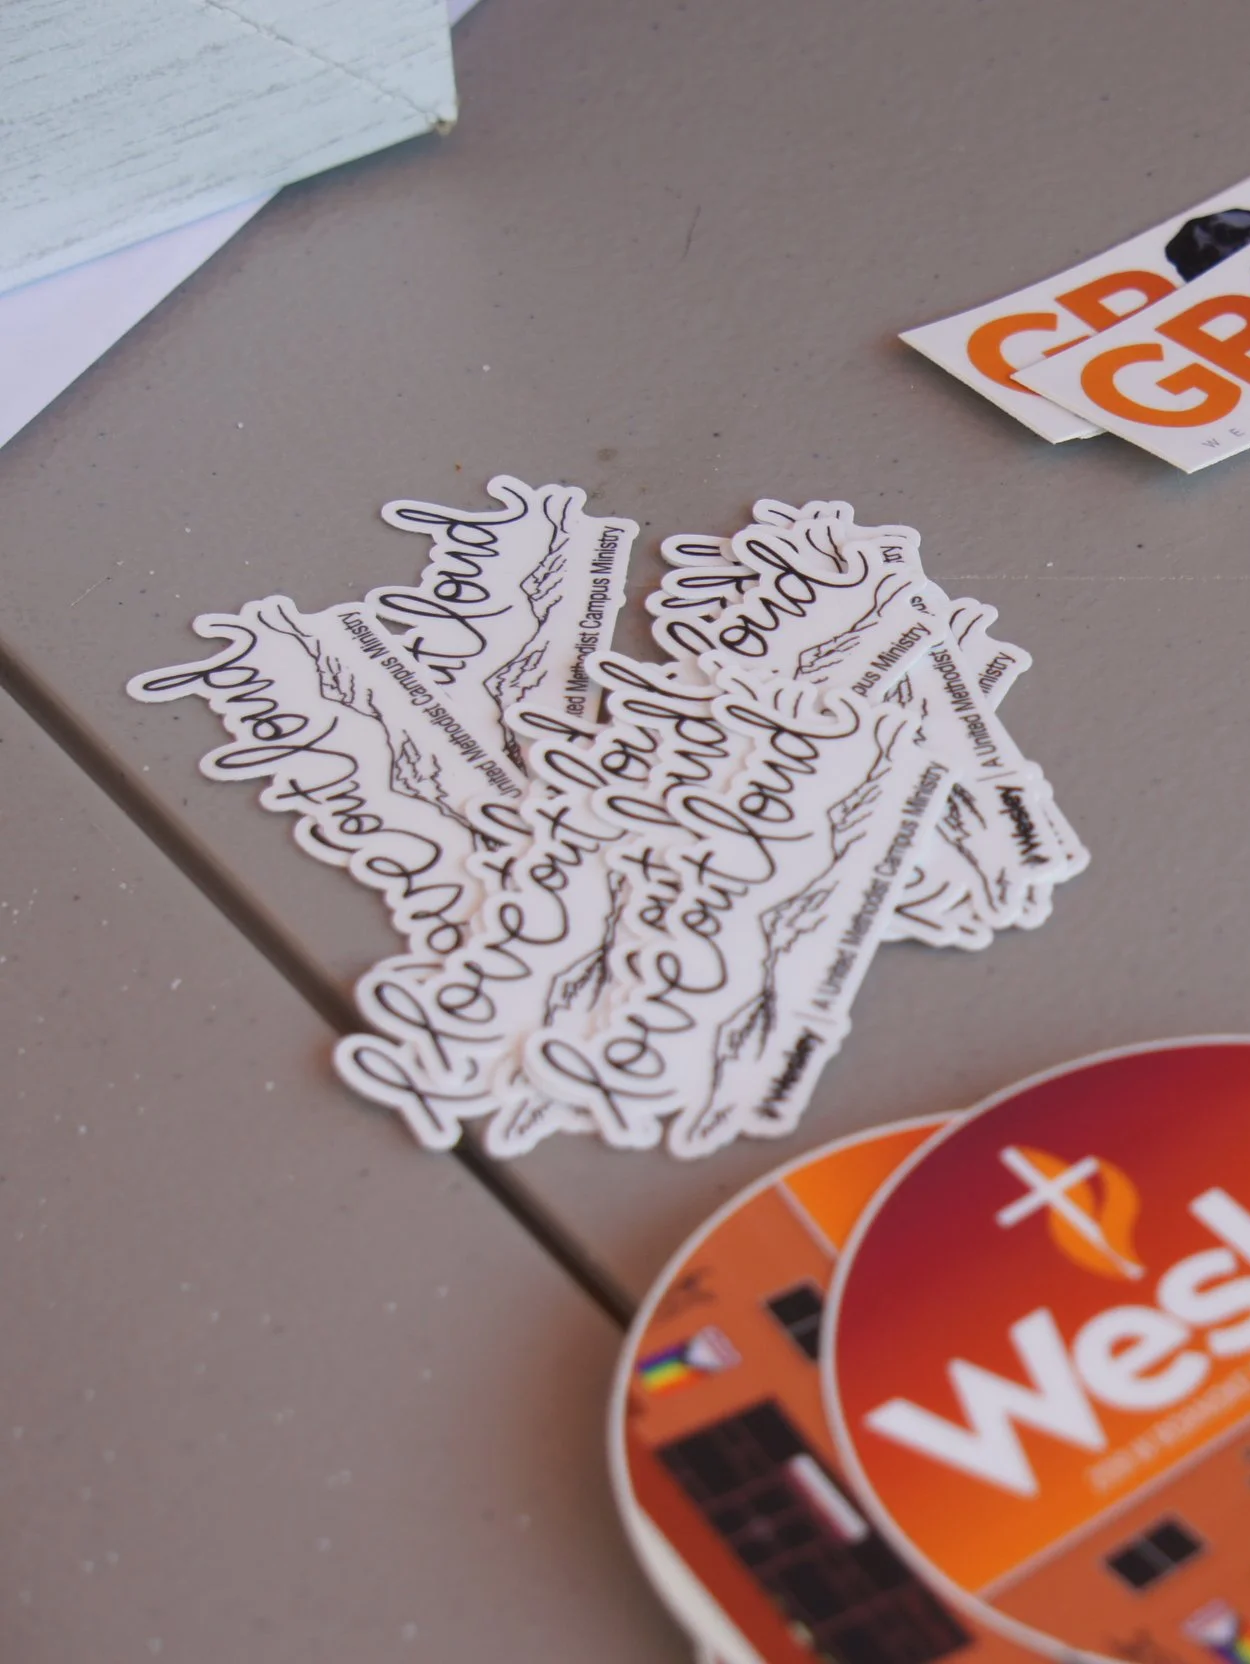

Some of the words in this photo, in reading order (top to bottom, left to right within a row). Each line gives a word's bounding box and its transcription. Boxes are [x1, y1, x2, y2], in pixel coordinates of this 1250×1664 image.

[379, 485, 529, 630] loud
[589, 525, 626, 575] Ministry
[579, 576, 612, 629] Campus
[337, 611, 389, 660] Ministry
[870, 622, 932, 672] Ministry
[142, 622, 350, 770] loud
[381, 656, 434, 706] Campus
[927, 648, 976, 713] Methodist
[977, 651, 1017, 695] inistry
[422, 702, 489, 763] Methodist
[958, 714, 997, 757] United
[683, 697, 860, 842] loud
[874, 820, 919, 877] Campus
[901, 761, 949, 818] Ministry
[680, 850, 776, 938] out
[541, 950, 728, 1131] love
